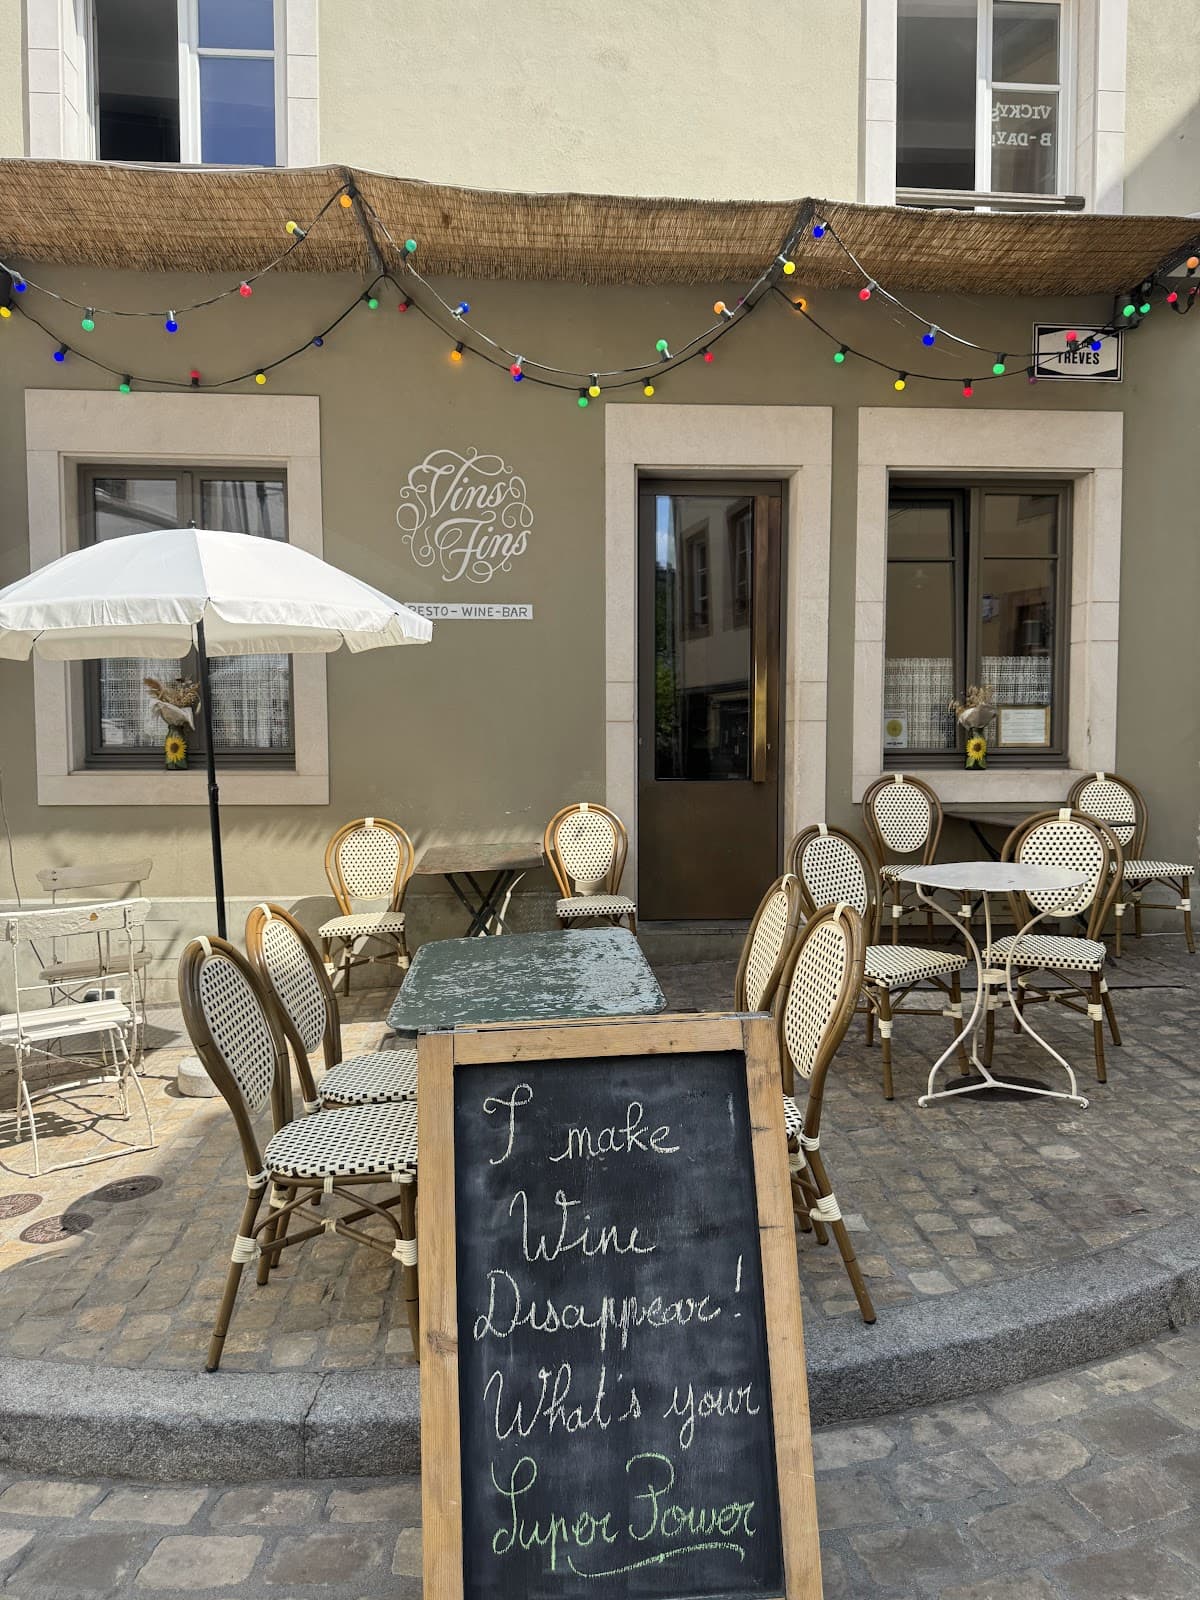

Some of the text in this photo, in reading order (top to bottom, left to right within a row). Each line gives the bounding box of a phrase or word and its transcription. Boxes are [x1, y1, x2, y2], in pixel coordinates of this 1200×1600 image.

[1057, 352, 1100, 364] TREVES
[408, 449, 509, 518] Vins
[434, 510, 531, 582] Fins
[549, 1101, 680, 1162] make
[509, 1190, 656, 1262] Wine
[483, 1361, 760, 1450] What's your
[491, 1452, 757, 1571] Super Power
